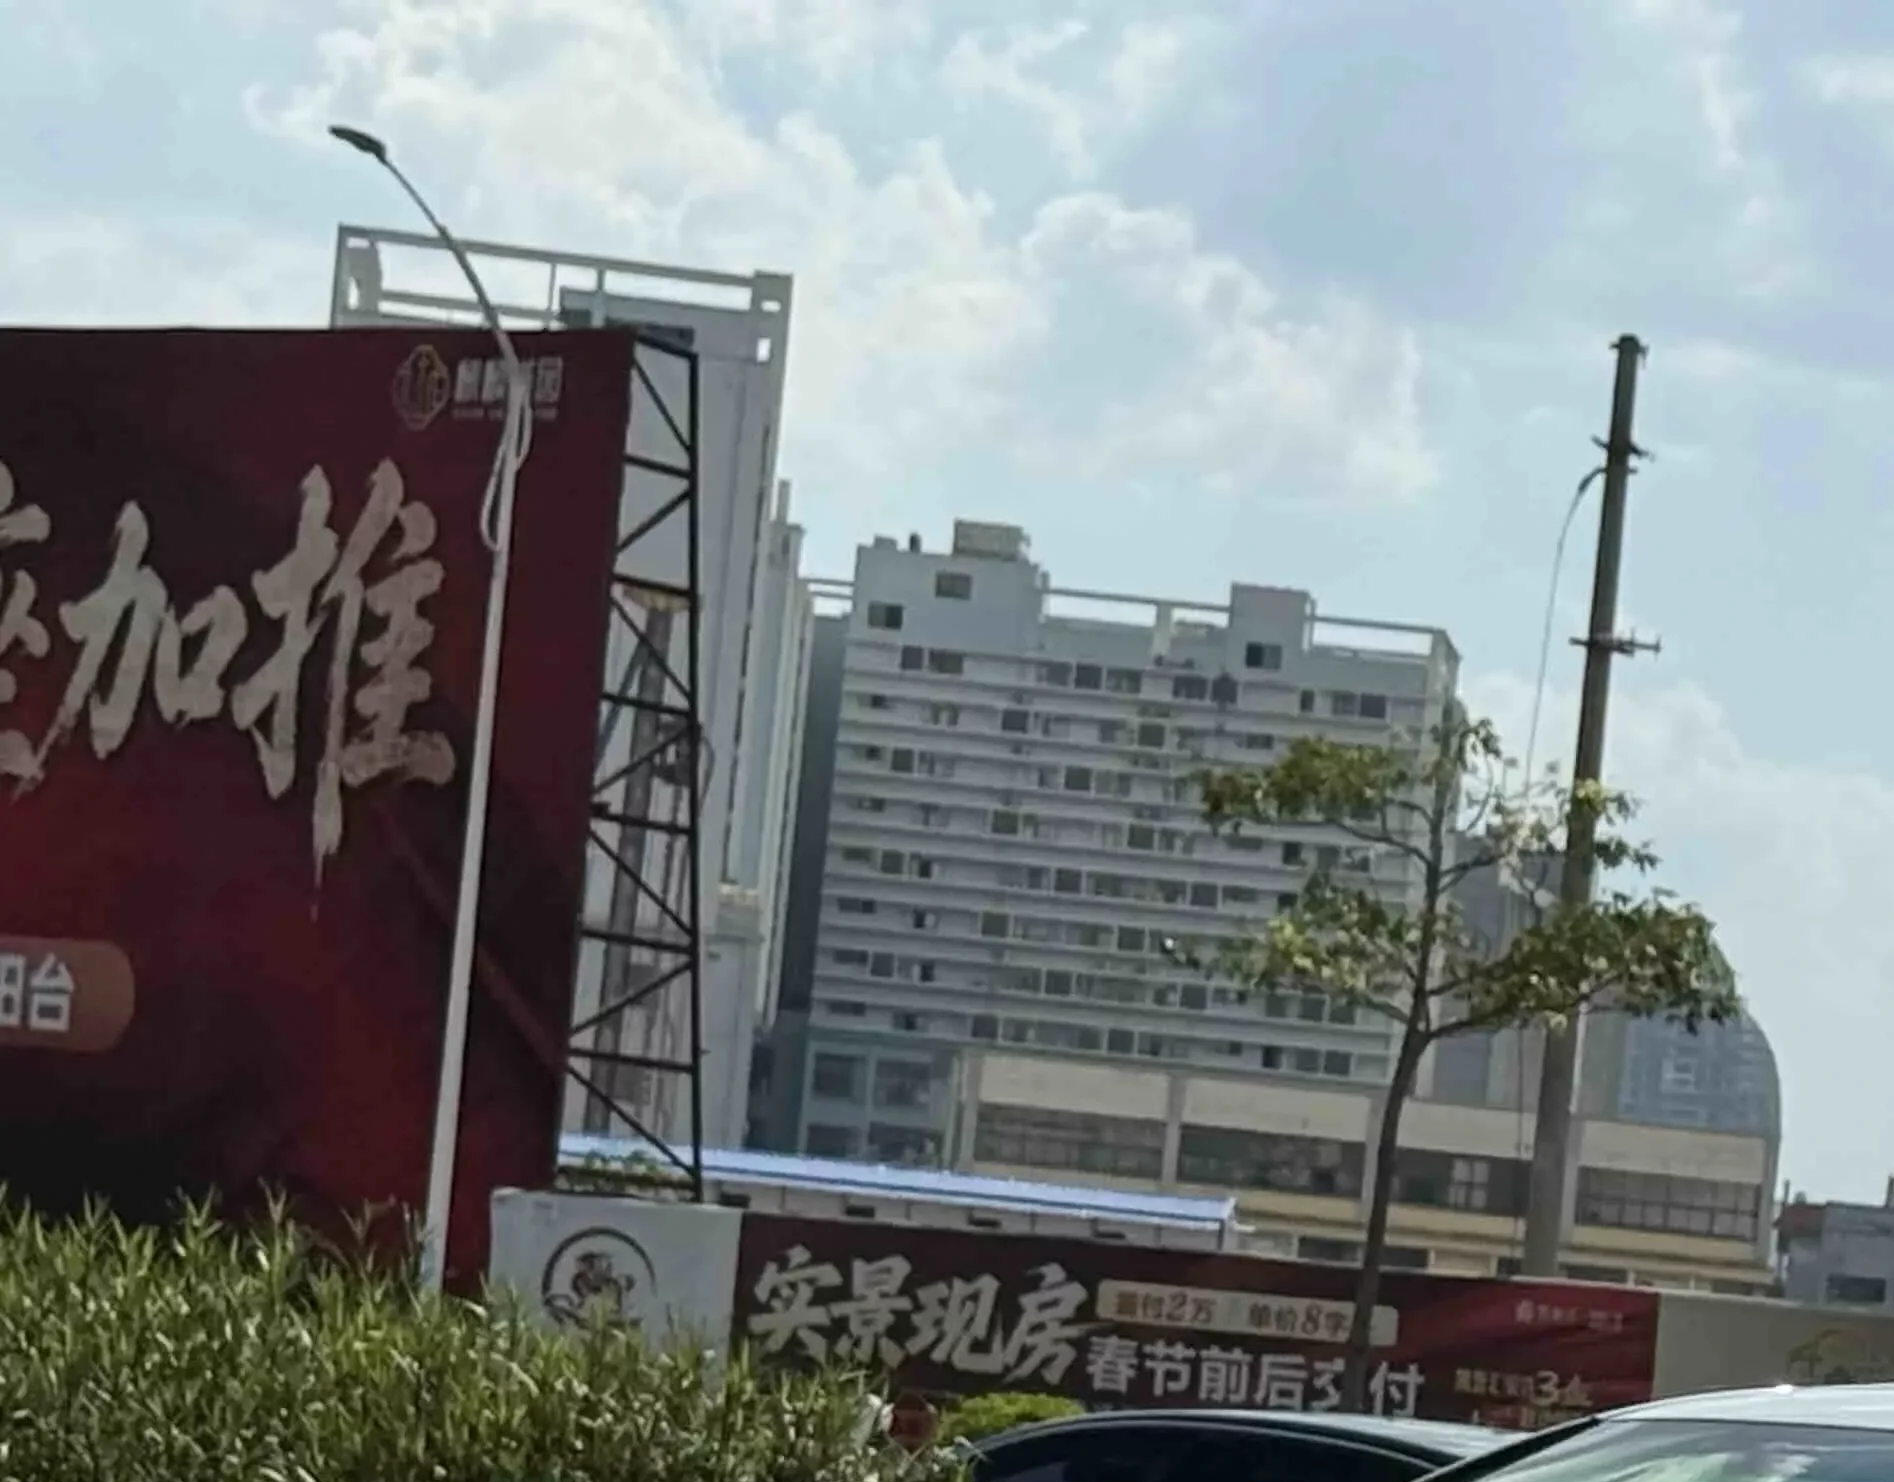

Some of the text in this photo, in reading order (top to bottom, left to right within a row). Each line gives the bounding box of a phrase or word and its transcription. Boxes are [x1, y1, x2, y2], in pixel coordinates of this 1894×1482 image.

[748, 1244, 1114, 1387] 实景现房
[1248, 1301, 1374, 1338] 单价8字
